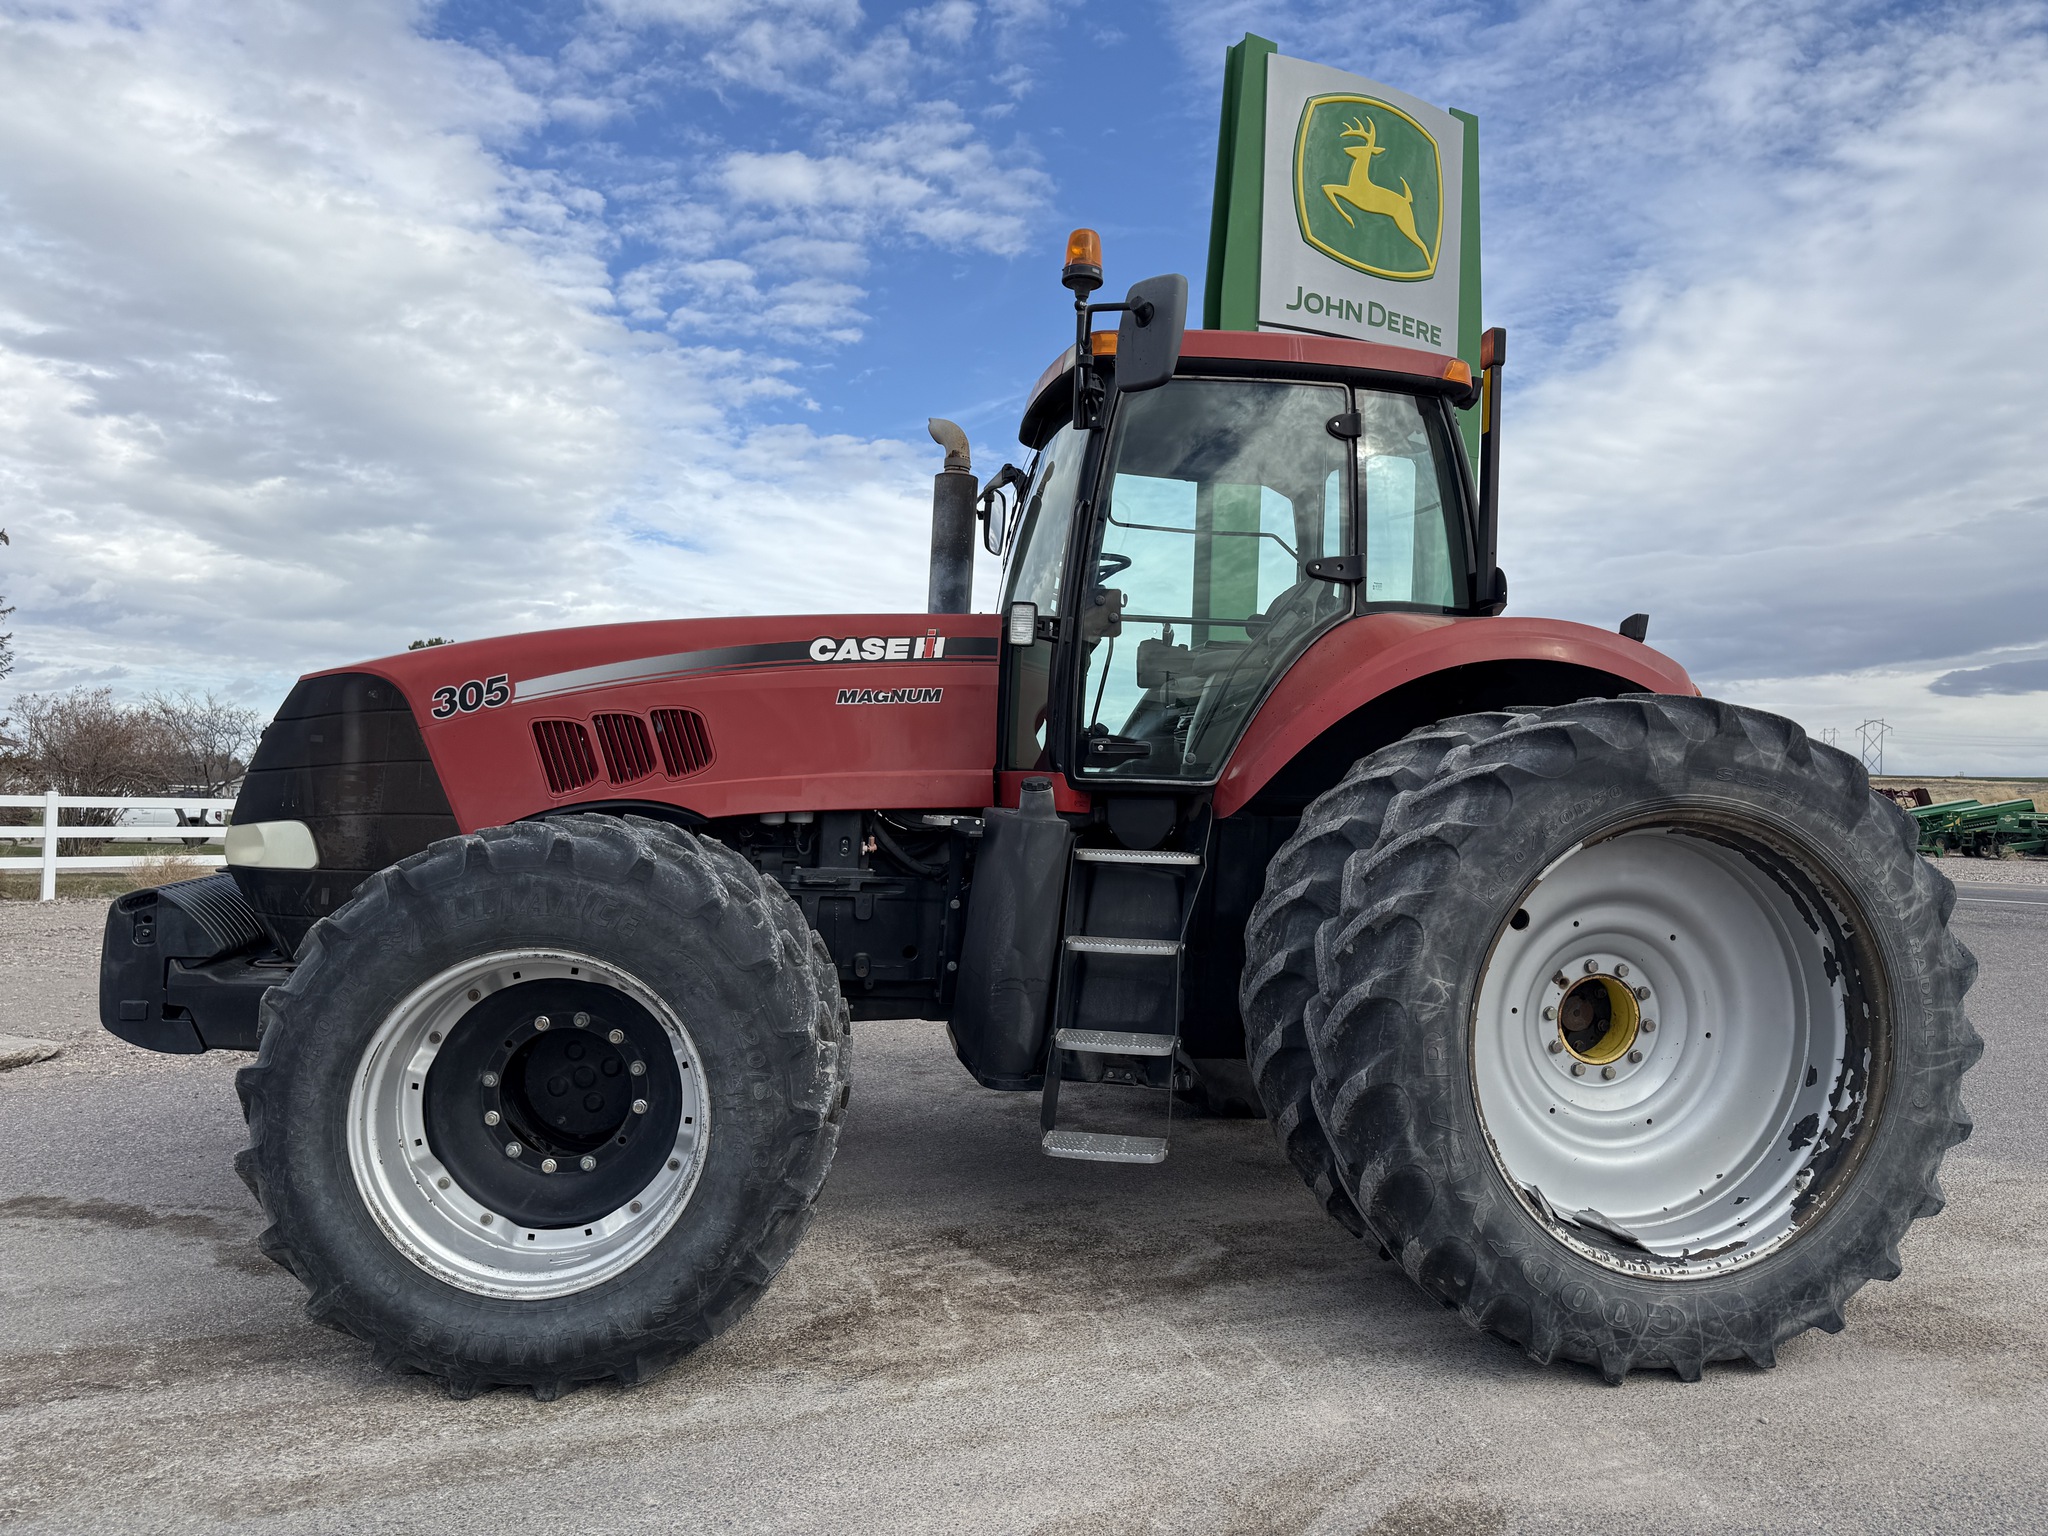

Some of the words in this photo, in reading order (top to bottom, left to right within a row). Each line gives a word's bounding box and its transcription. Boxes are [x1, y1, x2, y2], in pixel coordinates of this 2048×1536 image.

[1286, 286, 1363, 323] JOHN
[1368, 301, 1442, 347] DEERE
[809, 637, 911, 661] CASE
[431, 673, 510, 720] 305
[836, 687, 943, 704] MAGNUM
[405, 885, 650, 952] ALLIANCE
[1905, 936, 1936, 1047] RADIAL
[1421, 1030, 1687, 1337] GOODYEAR
